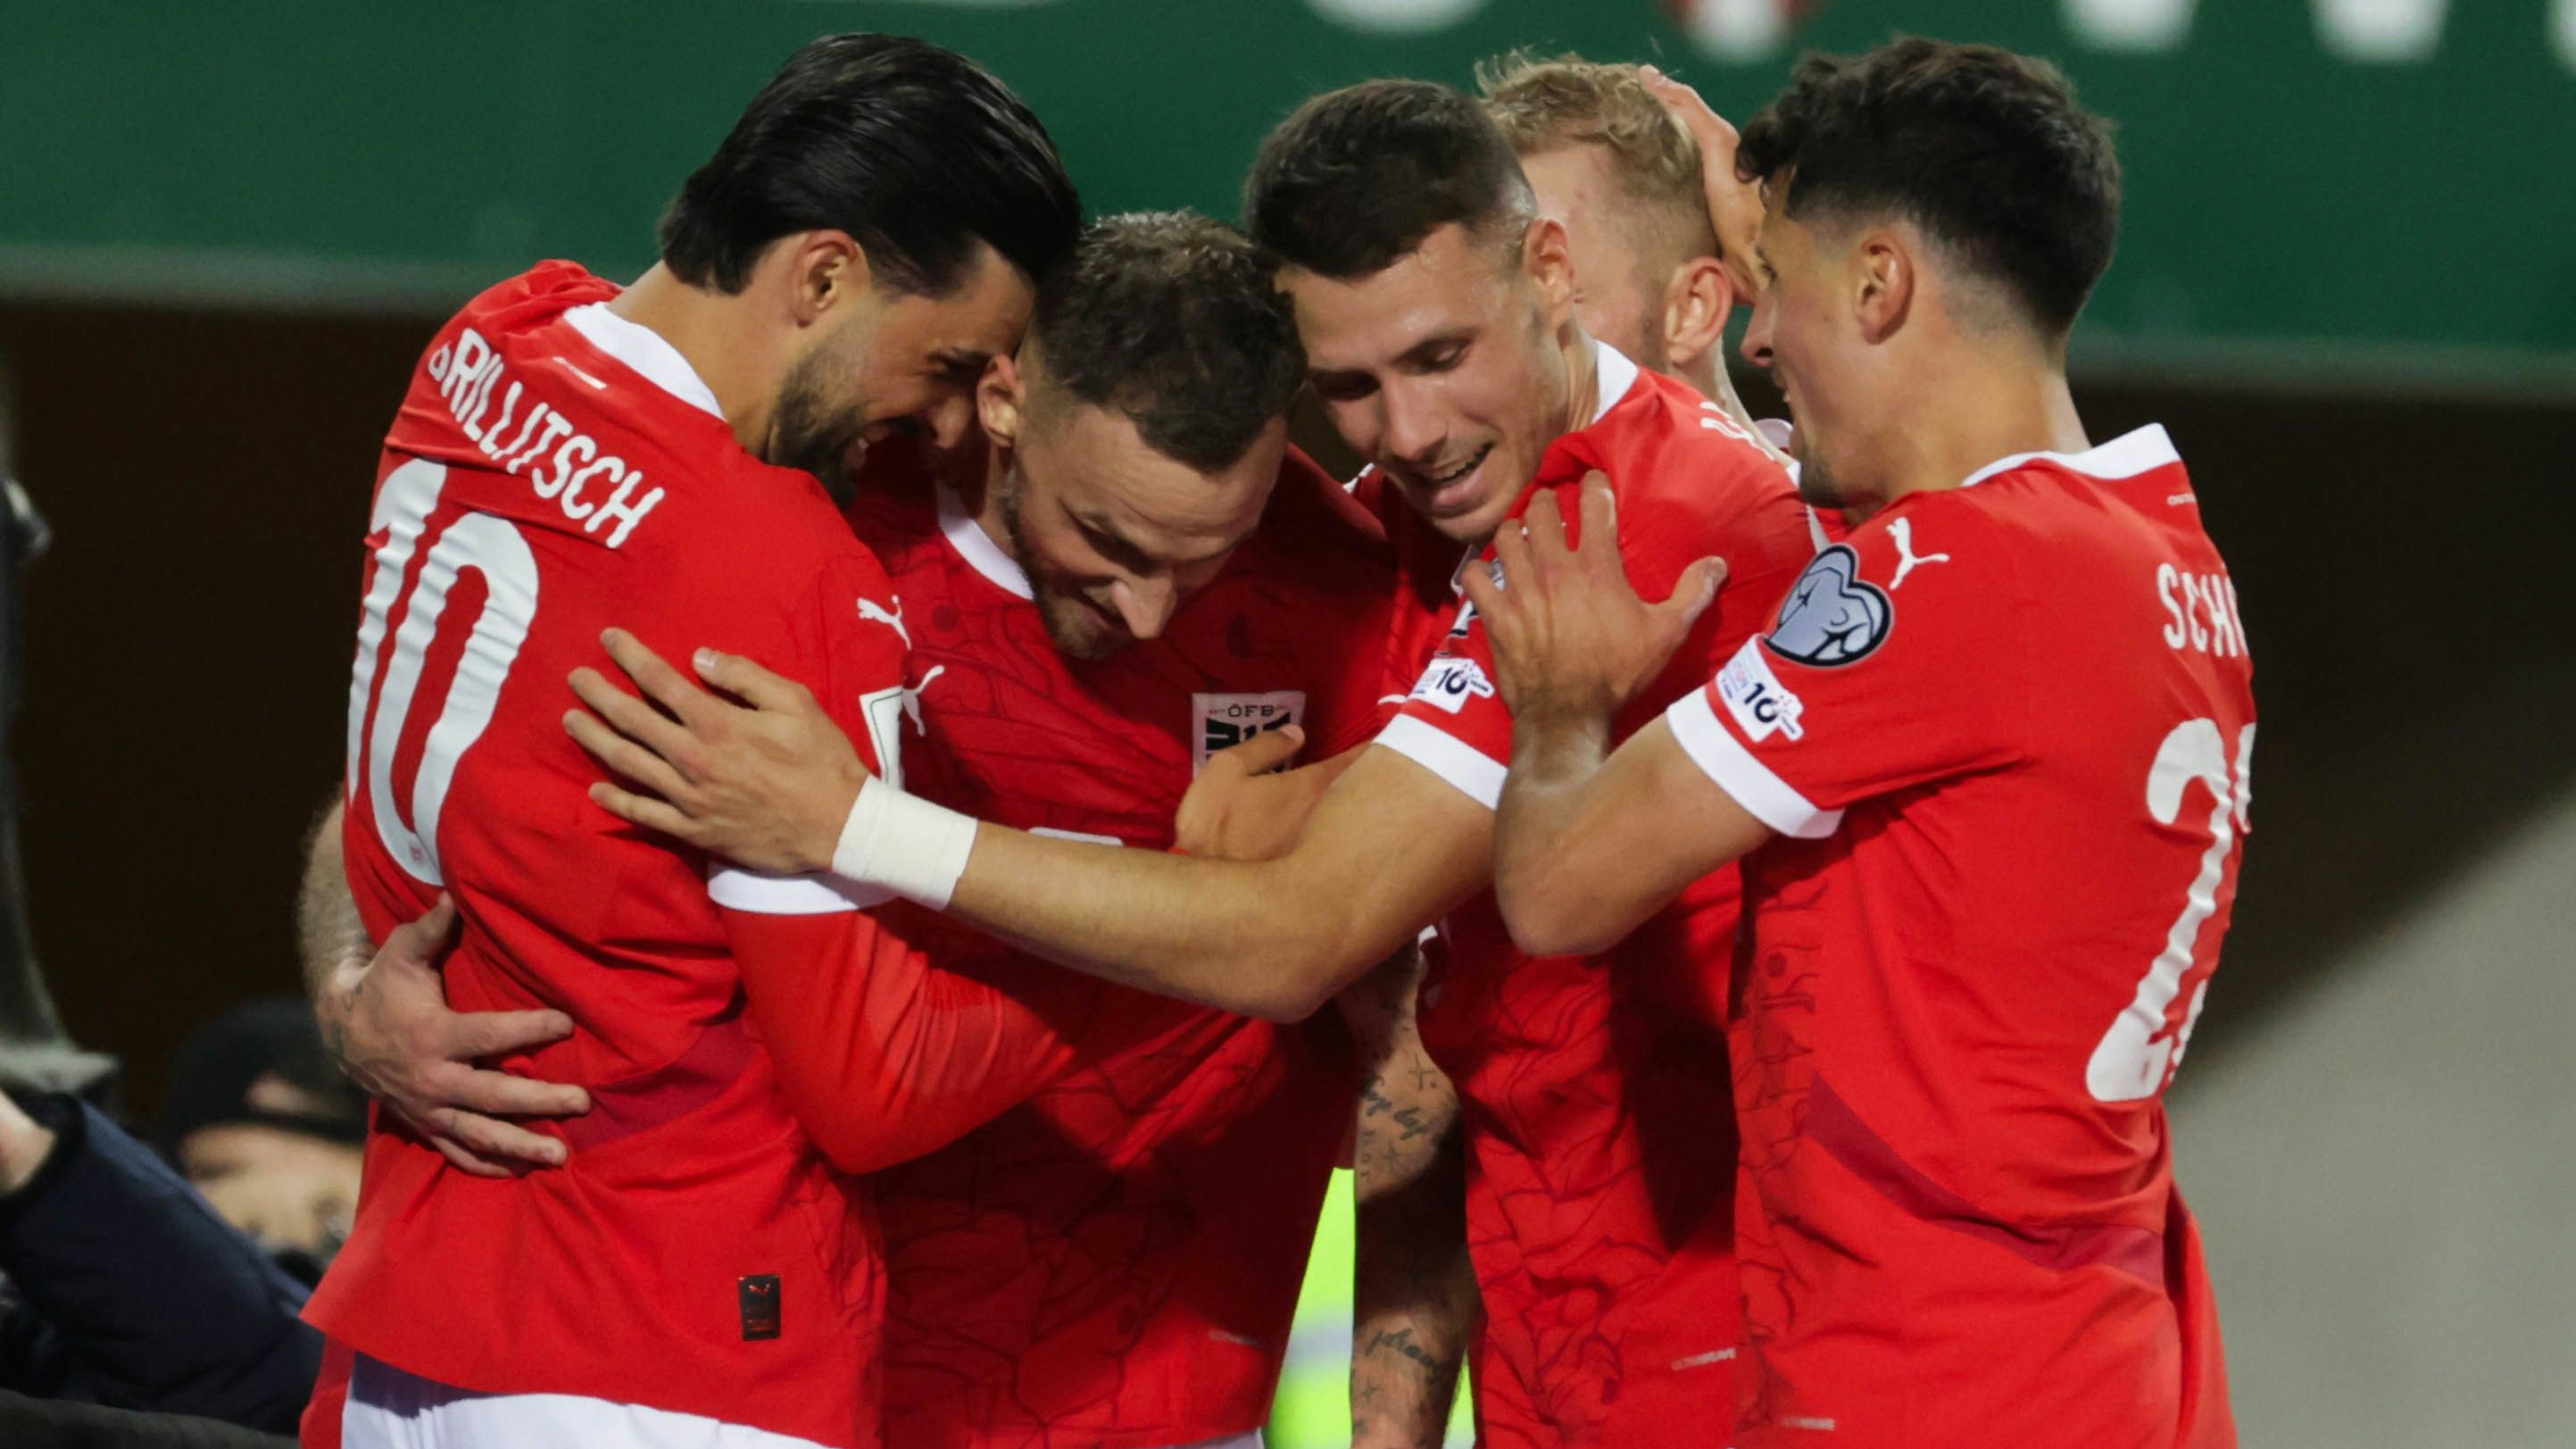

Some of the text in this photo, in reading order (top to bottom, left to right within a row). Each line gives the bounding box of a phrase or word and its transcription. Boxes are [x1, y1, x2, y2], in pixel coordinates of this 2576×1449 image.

[348, 457, 539, 887] 10
[1228, 703, 1275, 718] ÖFB
[2087, 717, 2256, 1101] 2
